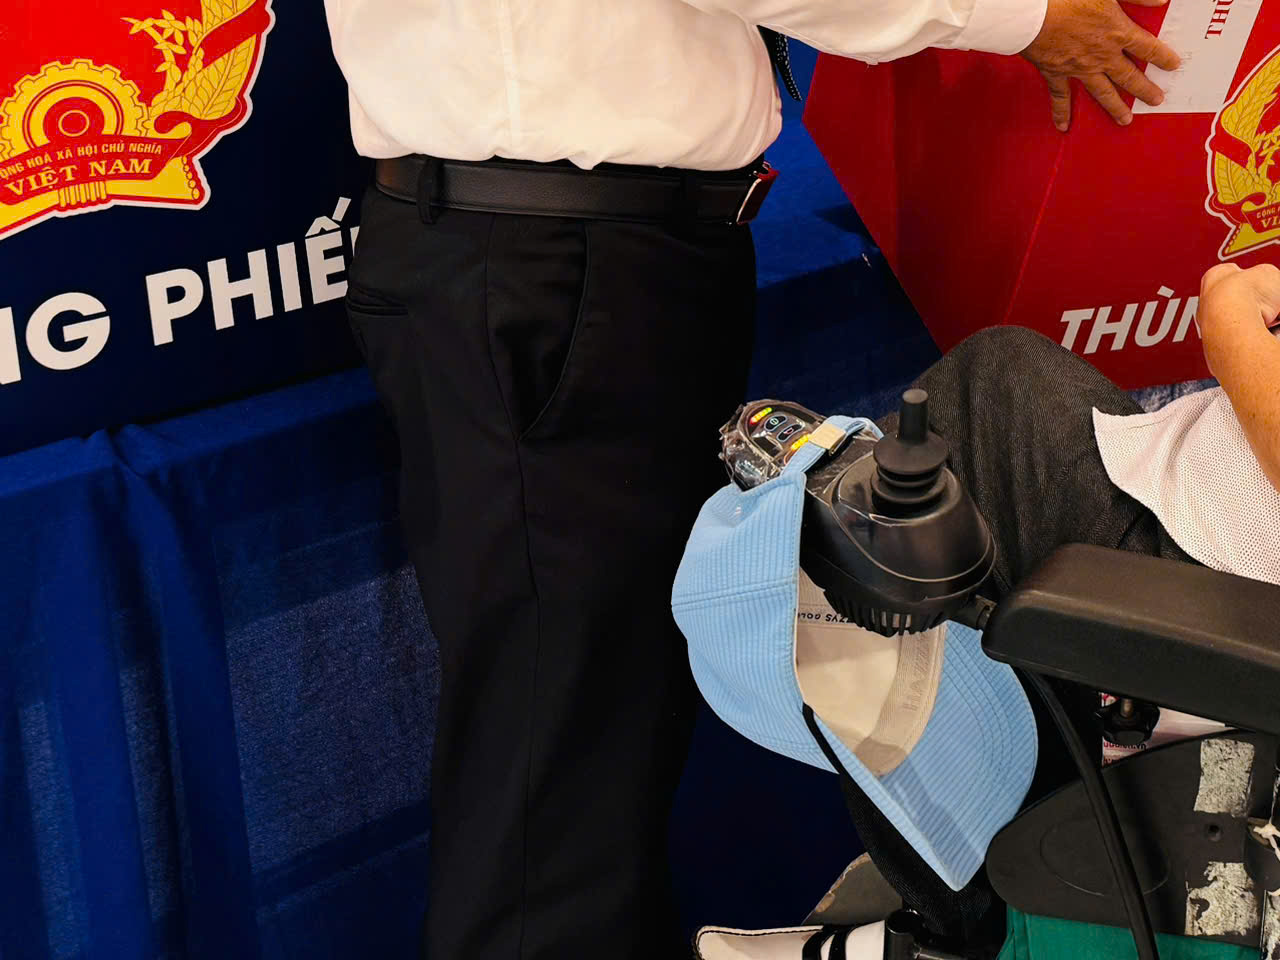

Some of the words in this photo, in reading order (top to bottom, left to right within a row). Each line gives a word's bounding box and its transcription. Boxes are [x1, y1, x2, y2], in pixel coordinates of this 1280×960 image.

[5, 164, 78, 196] VIỆT
[88, 158, 153, 177] NAM
[146, 196, 360, 346] PHIẾ
